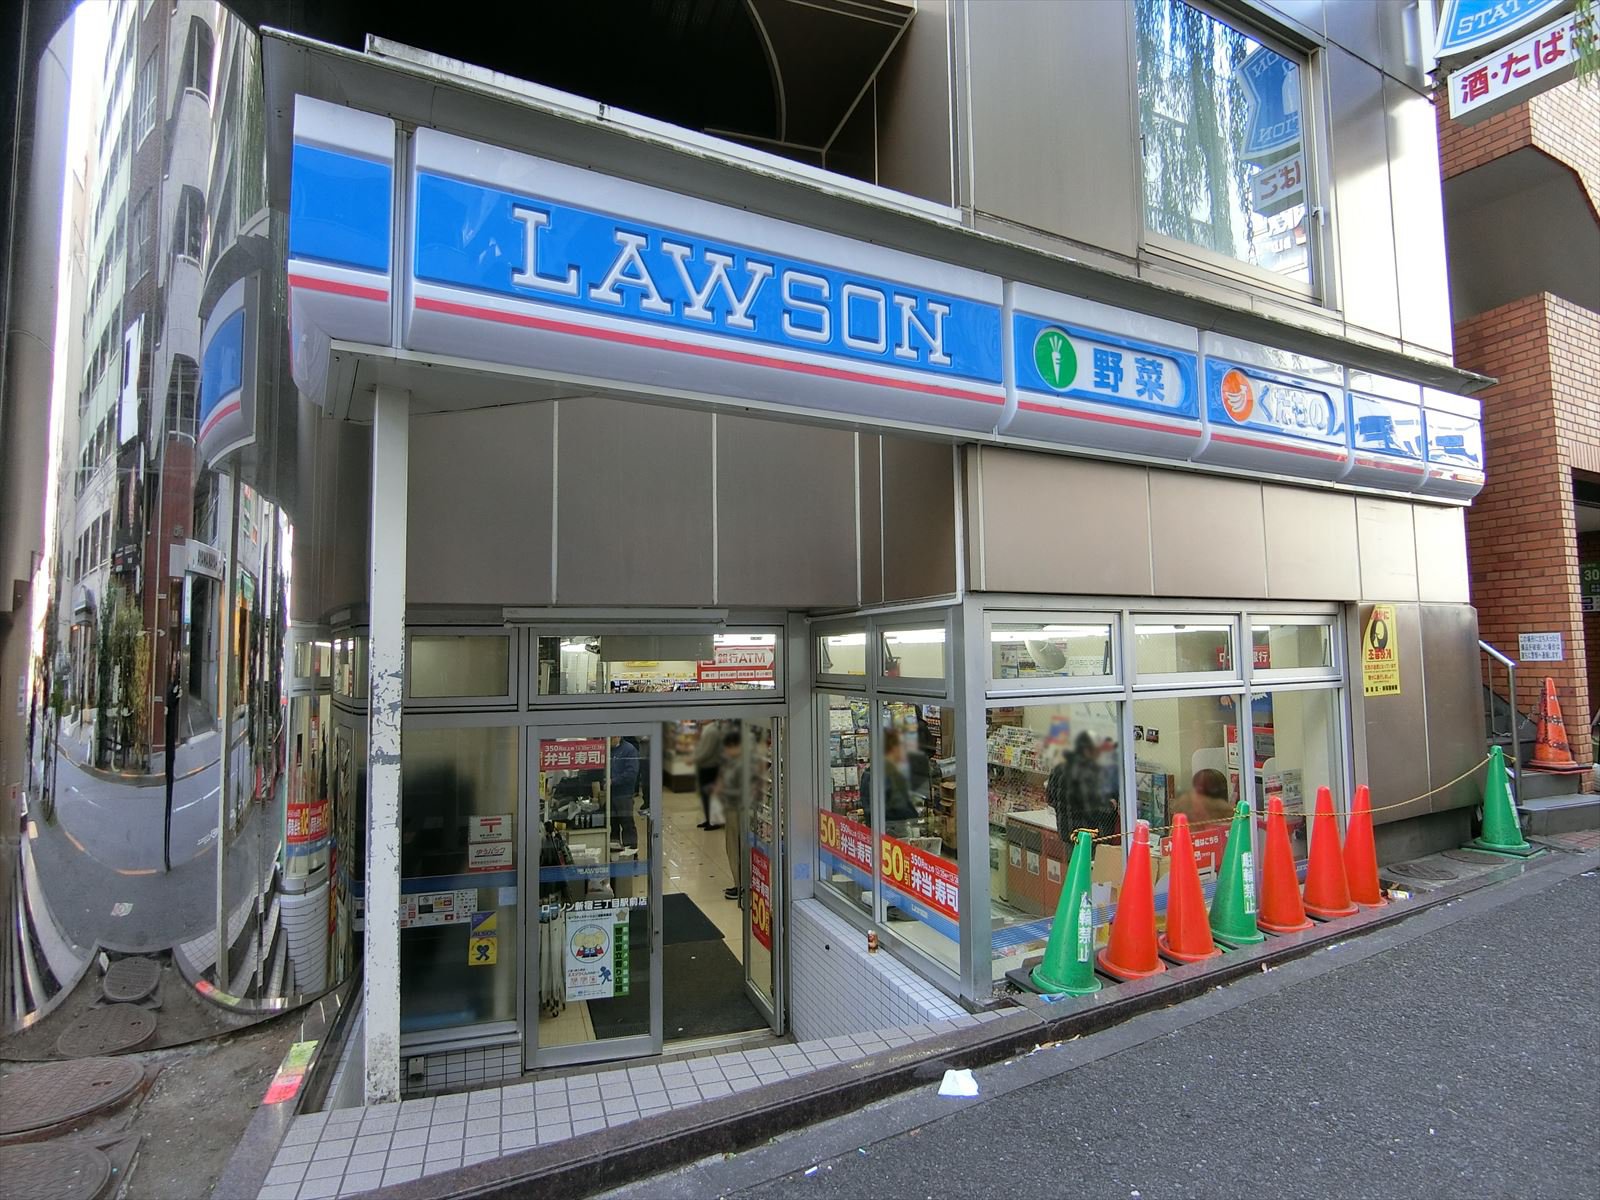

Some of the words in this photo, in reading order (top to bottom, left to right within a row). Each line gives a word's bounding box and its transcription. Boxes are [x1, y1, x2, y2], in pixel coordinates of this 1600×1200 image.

[1457, 0, 1539, 36] STAT
[512, 206, 953, 366] LAWSON
[1092, 347, 1165, 401] 野菜
[910, 866, 960, 913] 弁当・寿司
